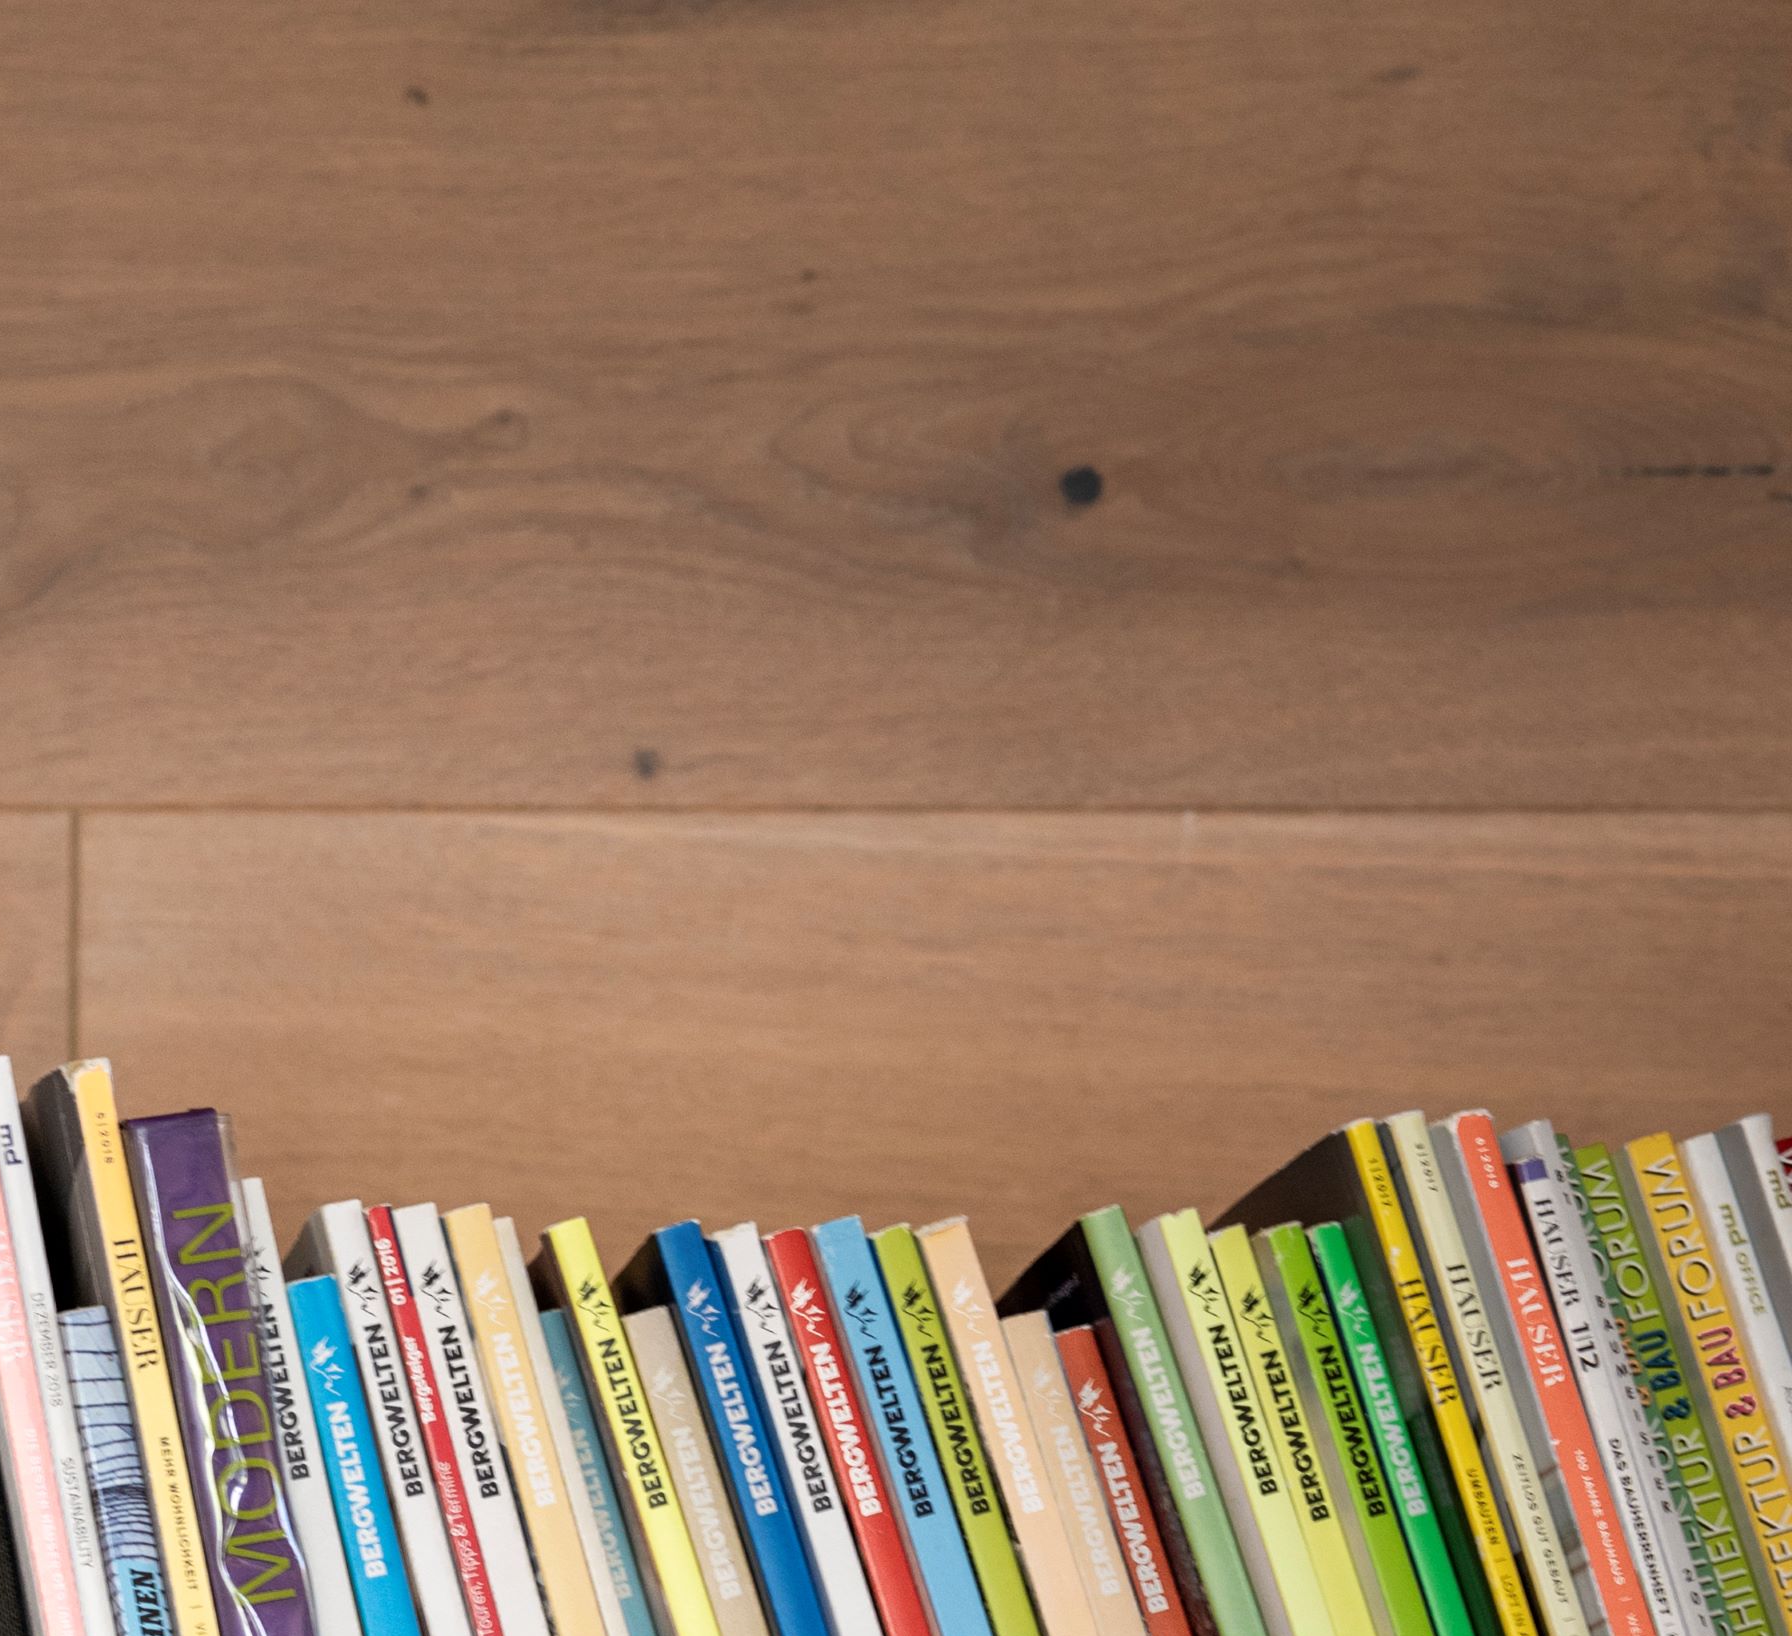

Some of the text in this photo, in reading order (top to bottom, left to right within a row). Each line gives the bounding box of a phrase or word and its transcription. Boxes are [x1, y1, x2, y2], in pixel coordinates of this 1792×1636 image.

[1575, 1155, 1660, 1320] FORUM
[1641, 1153, 1747, 1389] BAU FORUM
[1736, 1251, 1766, 1316] OFFICE
[174, 1201, 297, 1604] MODERN
[254, 1302, 310, 1480] BERGWELTEN
[365, 1323, 424, 1497] BERGWELTEN
[437, 1324, 500, 1497] BERGWELTEN
[492, 1332, 556, 1506] BERGWELTEN
[597, 1336, 667, 1507] BERGWELTEN
[706, 1342, 779, 1515] BERGWELTEN
[763, 1339, 833, 1512] BERGWELTEN
[810, 1342, 883, 1515] BERGWELTEN
[867, 1344, 934, 1517] BERGWELTEN
[921, 1343, 991, 1514] BERGWELTEN
[972, 1340, 1045, 1512] BERGWELTEN
[1130, 1325, 1206, 1499] BERGWELTEN
[1209, 1323, 1280, 1495] BERGWELTEN
[1260, 1348, 1330, 1521] BERGWELTEN
[1316, 1344, 1388, 1517] BERGWELTEN
[1356, 1341, 1429, 1516] BERGWELTEN
[1632, 1327, 1680, 1389] BAU
[326, 1401, 388, 1577] BERGWELTEN
[569, 1427, 632, 1598] BERGWELTEN
[672, 1425, 744, 1598] BERGWELTEN
[1050, 1425, 1120, 1594] BERGWELTEN
[1097, 1441, 1169, 1612] BERGWELTEN
